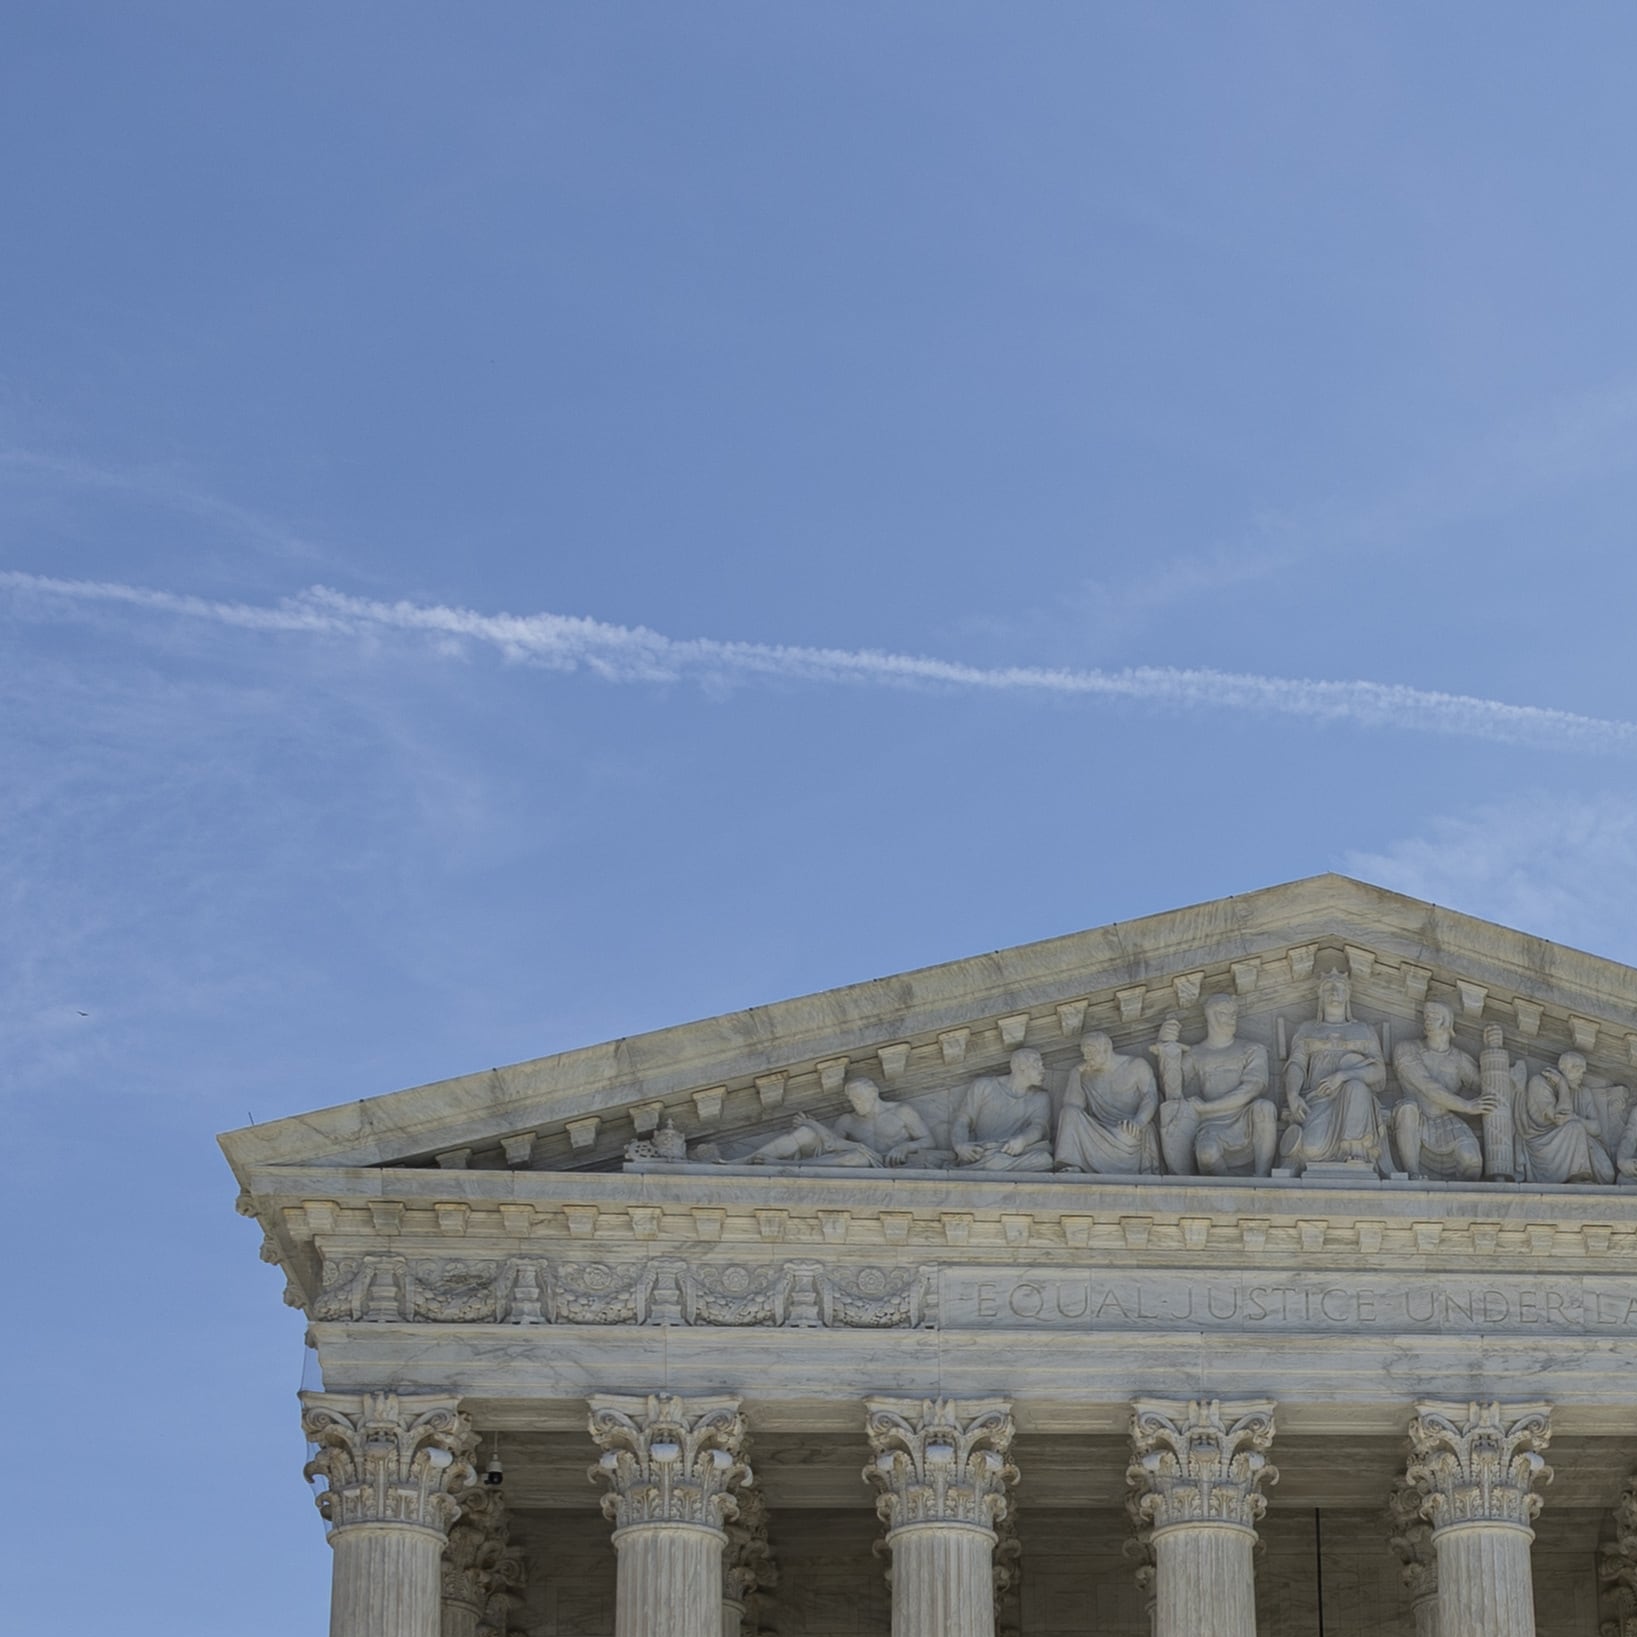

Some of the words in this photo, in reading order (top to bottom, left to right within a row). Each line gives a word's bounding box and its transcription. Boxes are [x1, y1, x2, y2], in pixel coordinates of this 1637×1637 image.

[976, 1283, 1158, 1322] EQUAL
[1170, 1287, 1377, 1322] JUSTICE
[1405, 1289, 1576, 1324] UNDER
